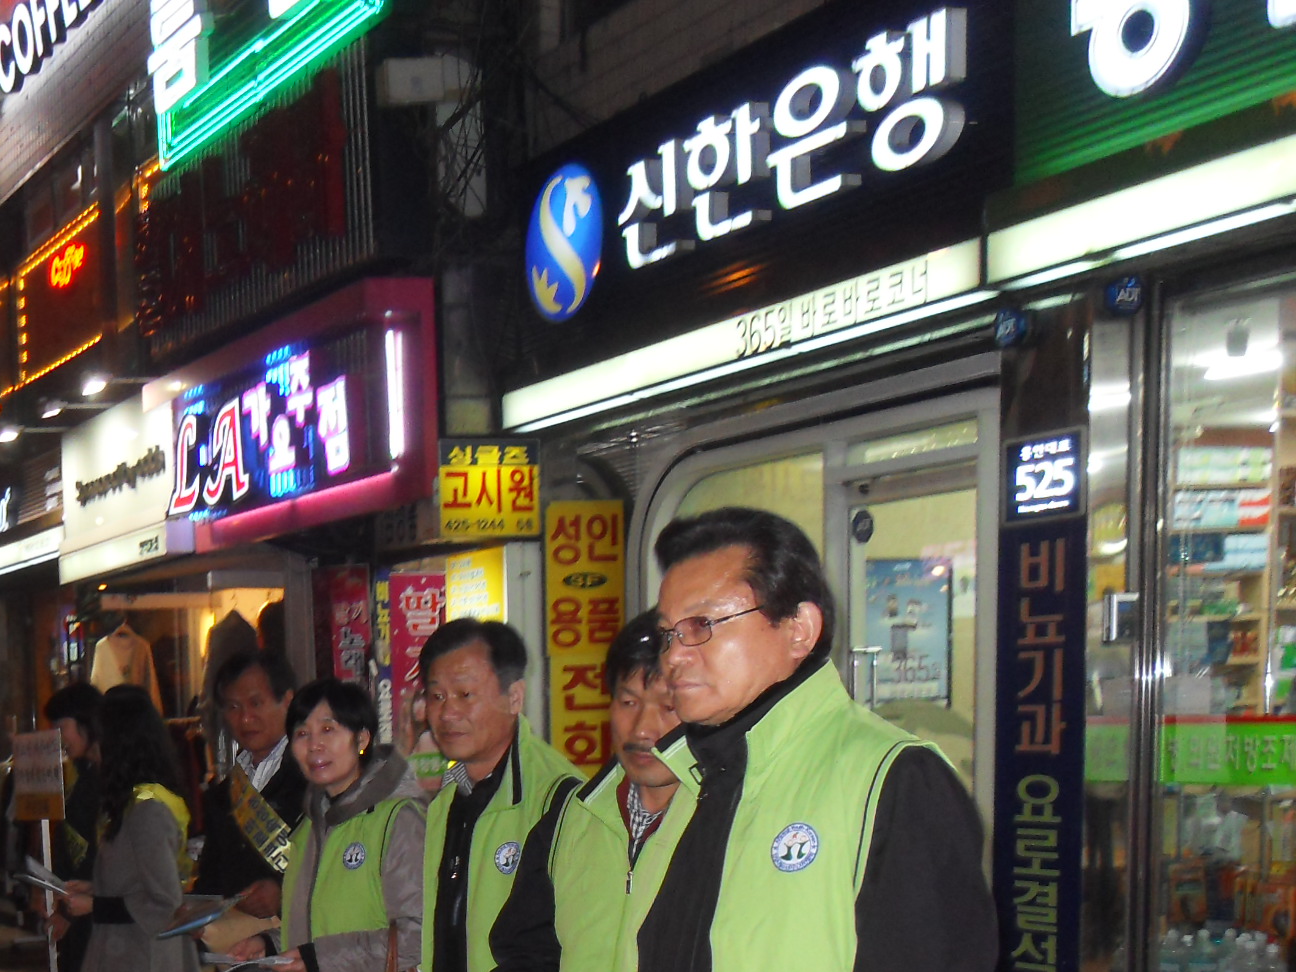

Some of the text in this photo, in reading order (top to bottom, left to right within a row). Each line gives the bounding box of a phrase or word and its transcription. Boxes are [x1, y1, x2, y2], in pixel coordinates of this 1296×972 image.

[617, 8, 950, 269] 신한은행
[1116, 287, 1141, 305] ADT
[735, 307, 793, 361] 365일
[169, 396, 249, 515] LA
[1015, 457, 1075, 501] 525
[443, 466, 536, 514] 고시원
[550, 514, 619, 566] 성인
[550, 597, 620, 649] 용품
[1015, 537, 1067, 756] 비뇨기과
